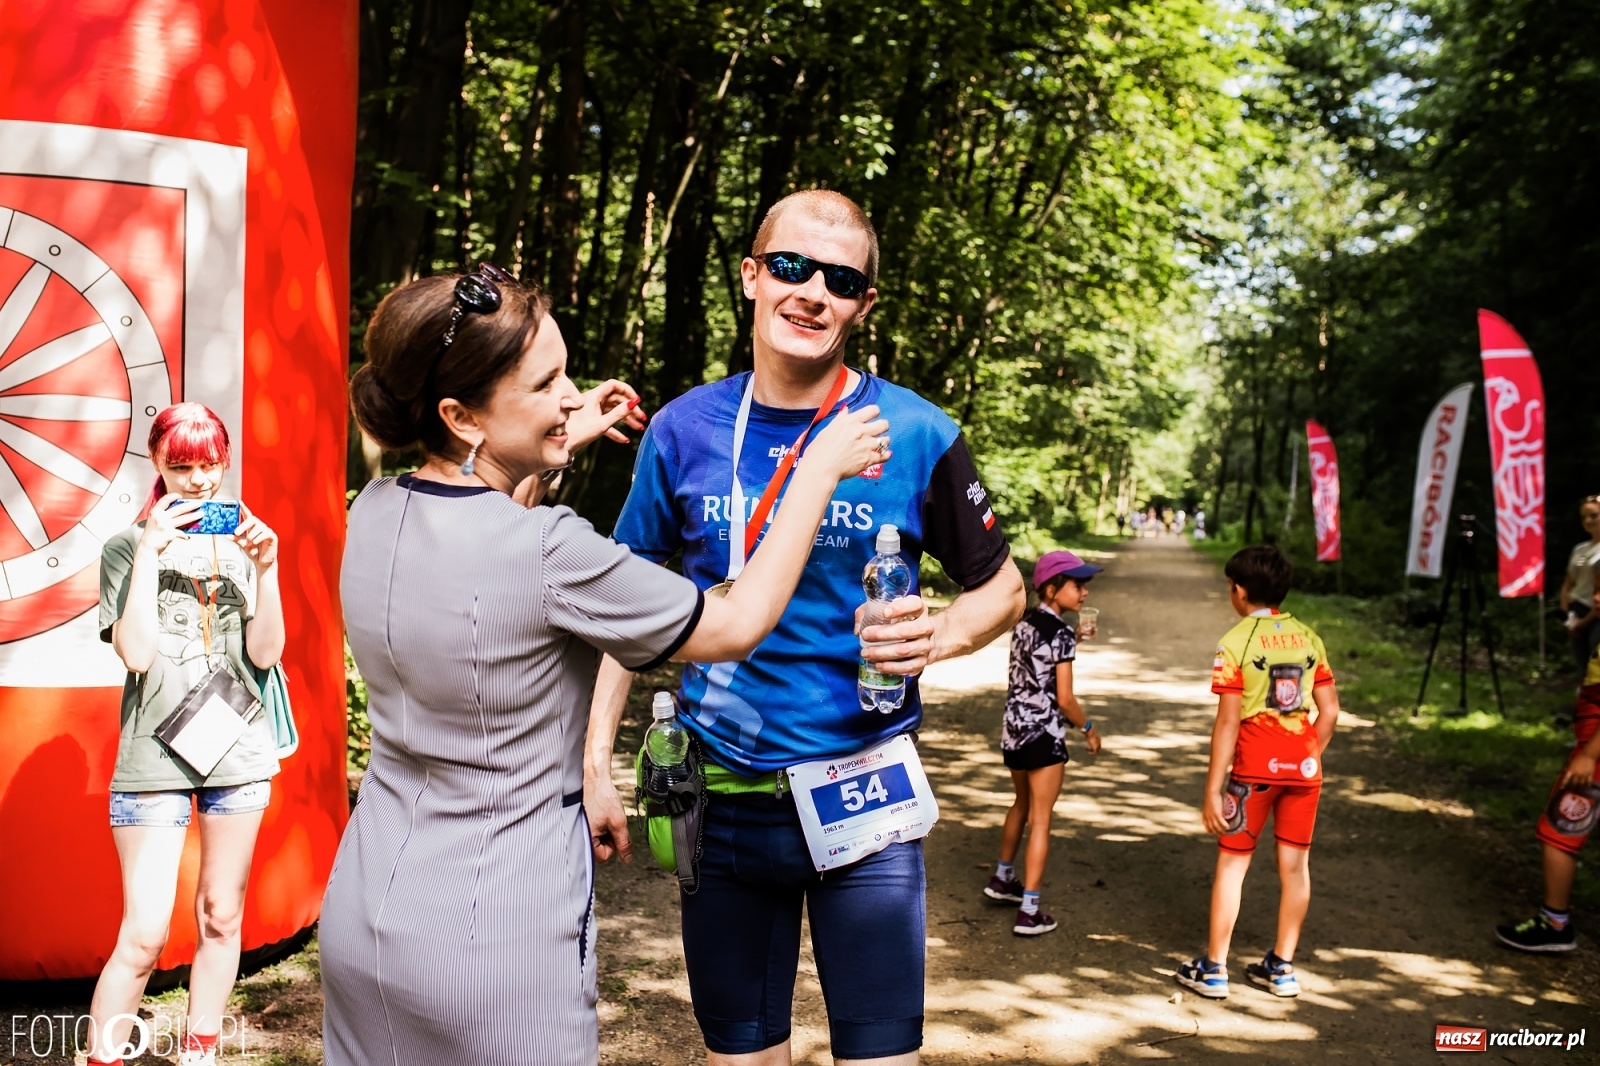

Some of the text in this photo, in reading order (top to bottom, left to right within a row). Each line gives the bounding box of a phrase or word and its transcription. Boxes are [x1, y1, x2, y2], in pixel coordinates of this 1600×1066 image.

[1418, 404, 1457, 571] RACIBÓRZ
[703, 496, 873, 531] RUNRS
[813, 534, 849, 549] EAM
[840, 774, 889, 812] 54
[823, 825, 838, 835] 1963
